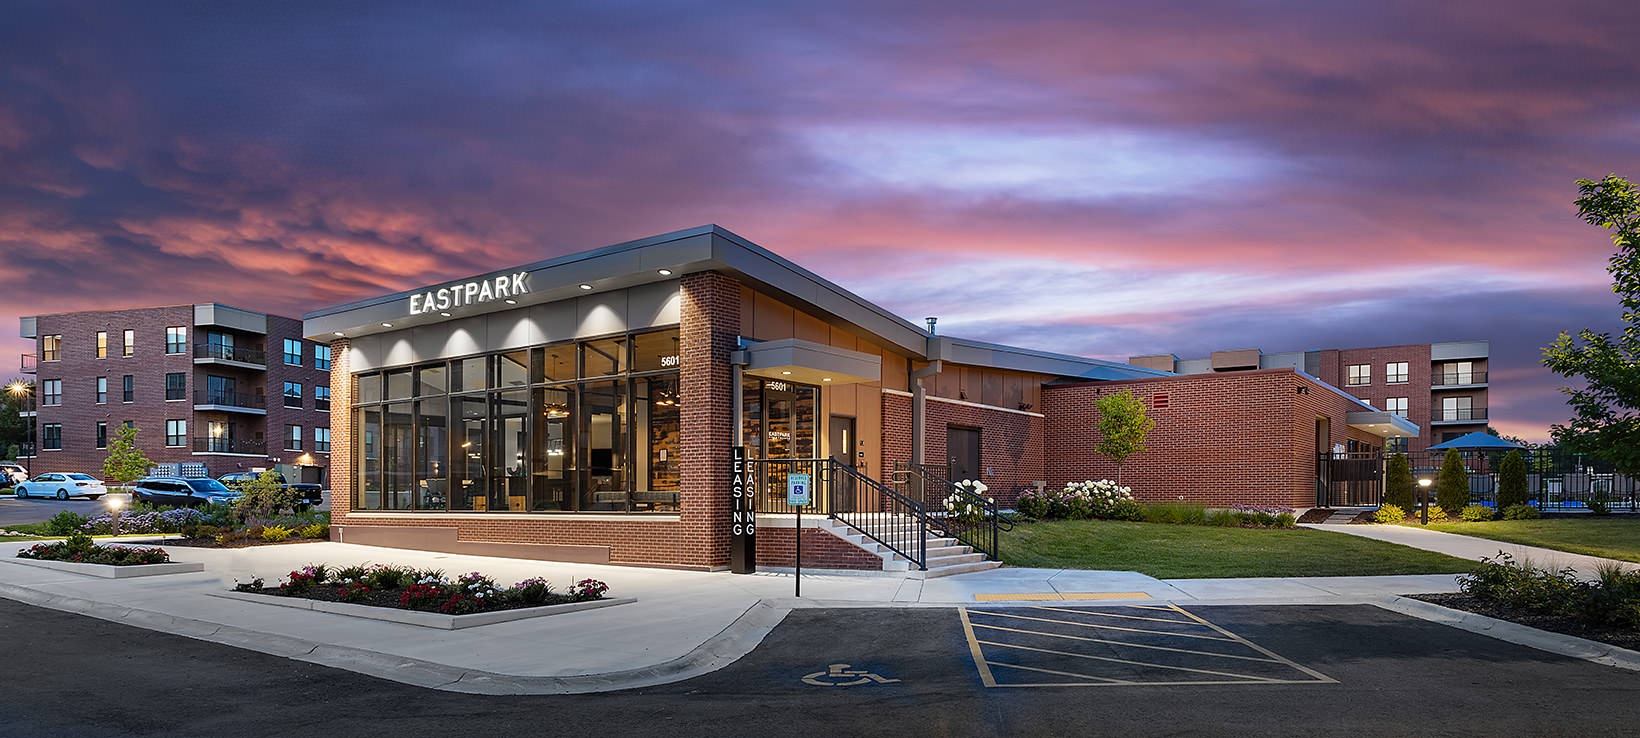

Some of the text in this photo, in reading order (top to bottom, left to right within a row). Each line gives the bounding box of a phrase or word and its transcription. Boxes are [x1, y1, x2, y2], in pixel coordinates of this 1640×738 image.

[409, 271, 528, 315] EASTPARK
[661, 355, 679, 366] 5601
[770, 381, 786, 391] 5601
[733, 449, 742, 535] LEASING
[746, 449, 754, 535] LEASING
